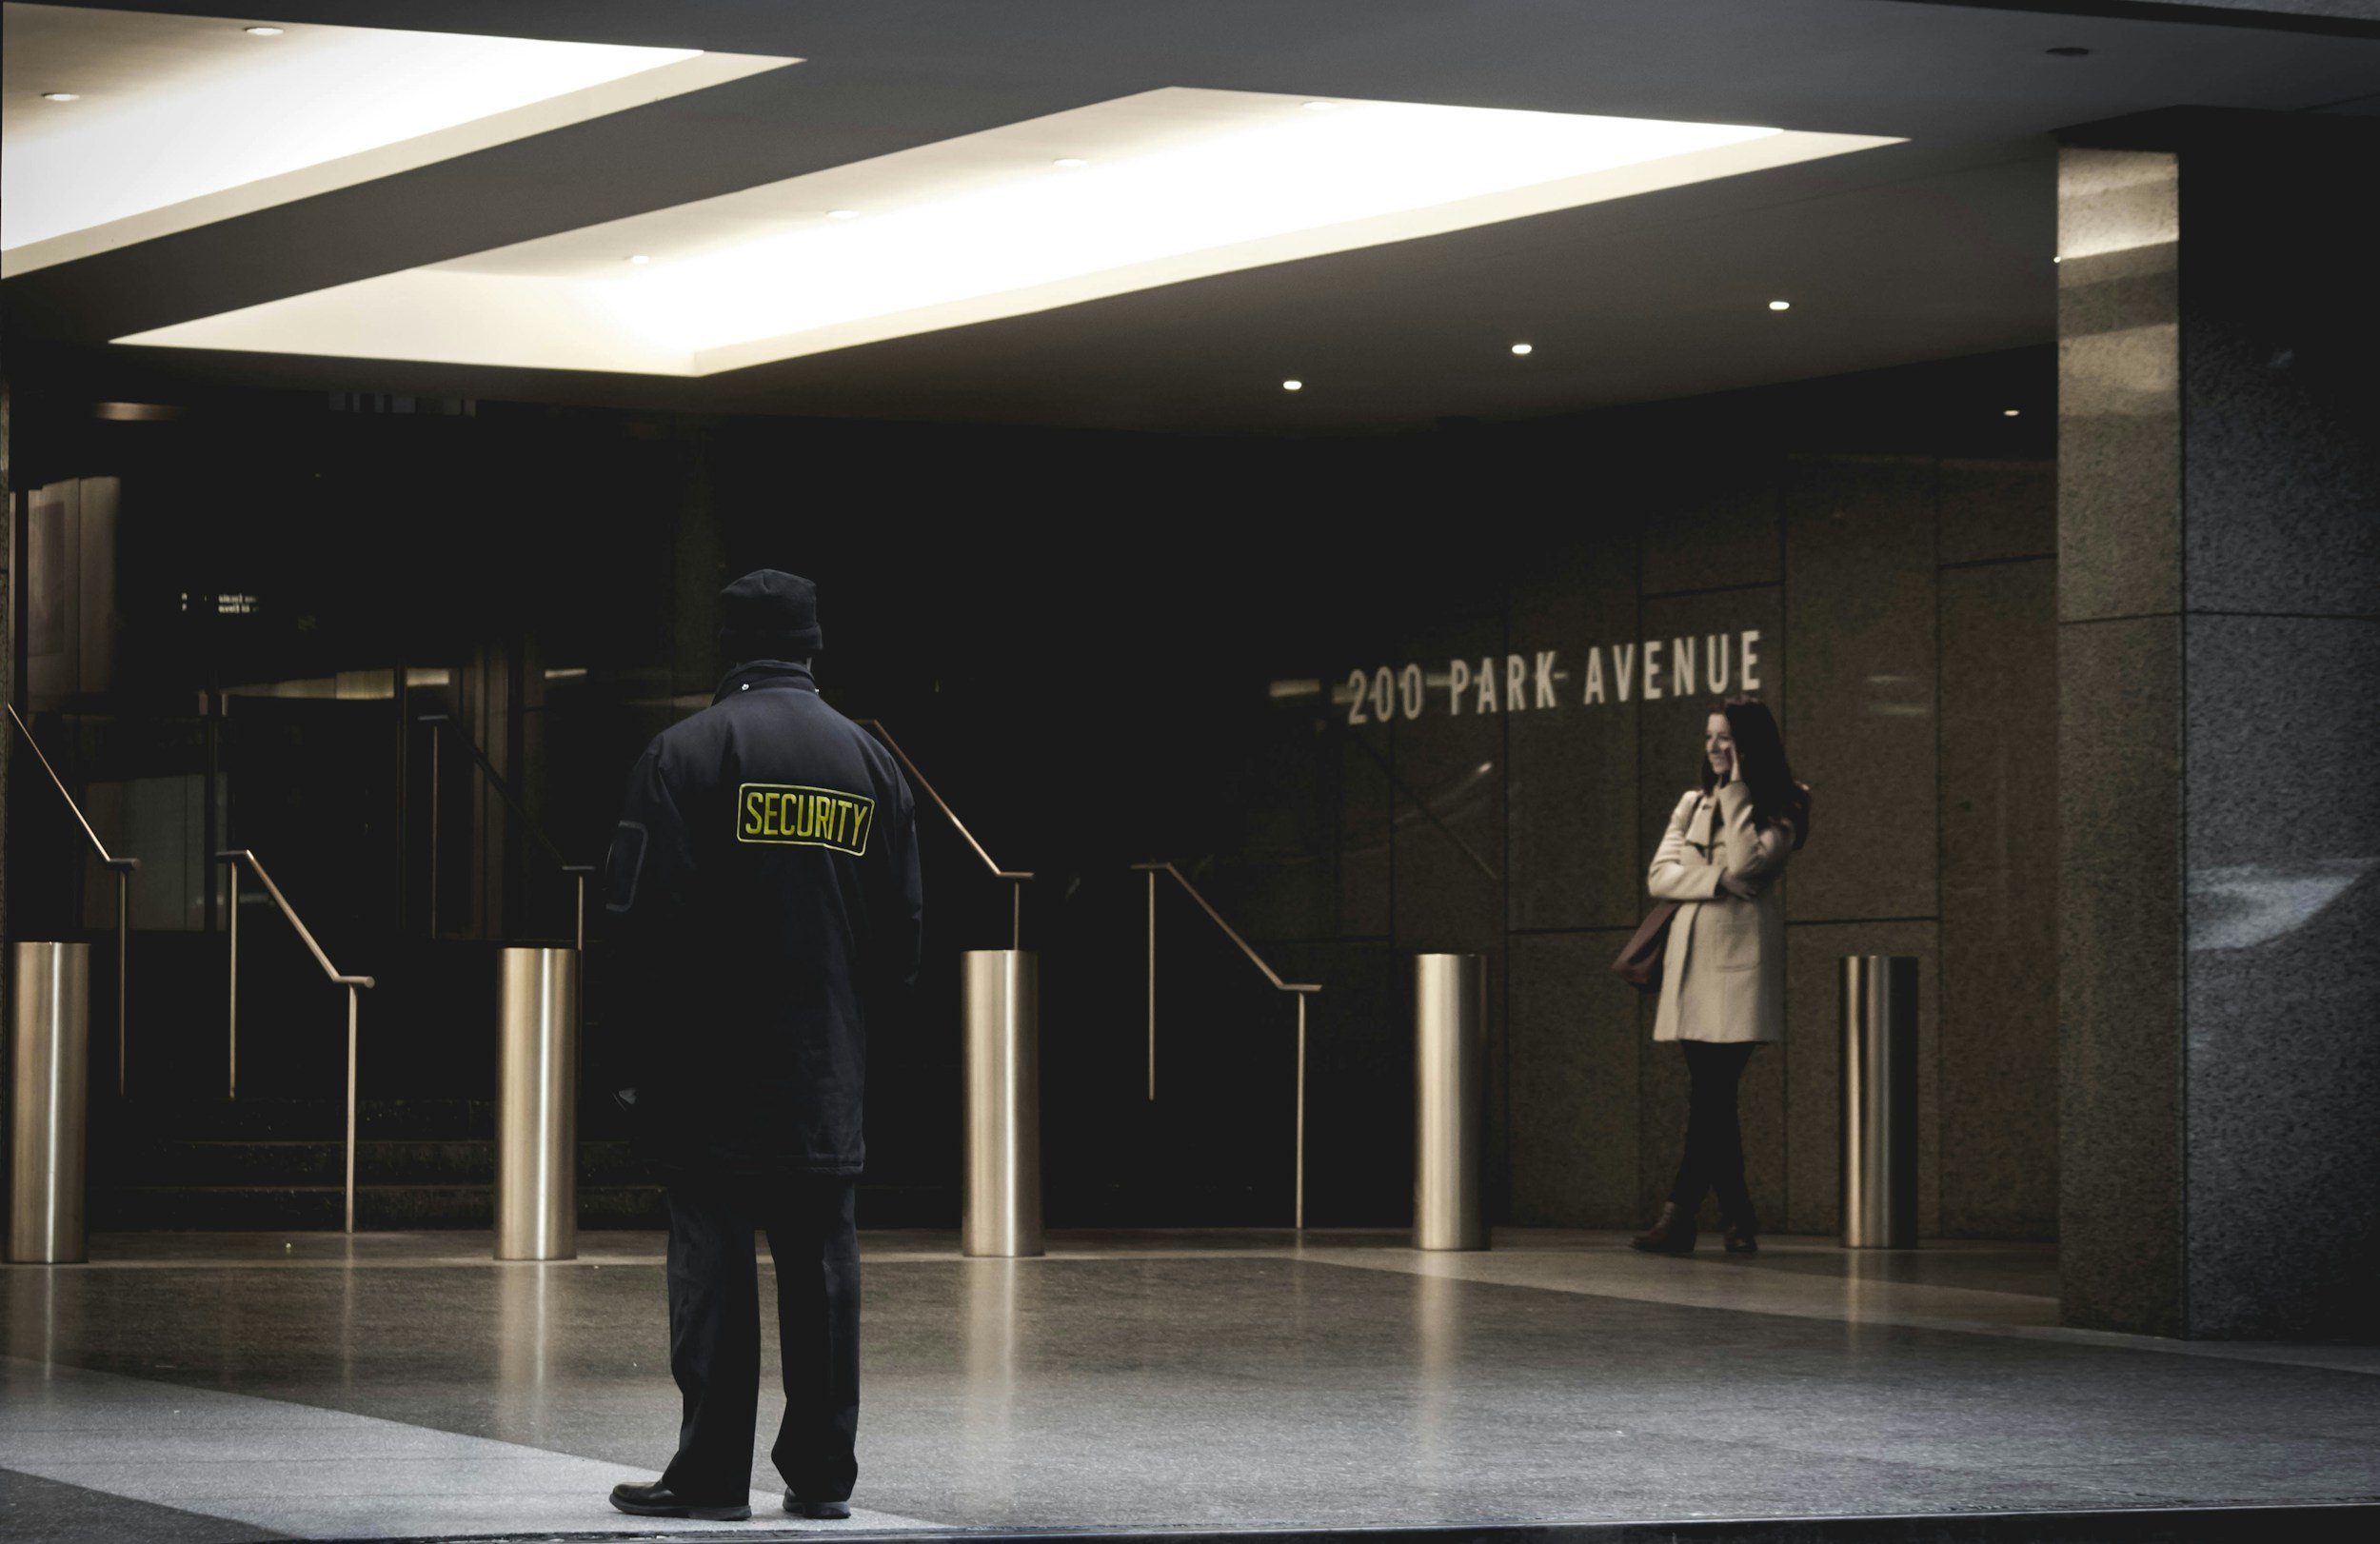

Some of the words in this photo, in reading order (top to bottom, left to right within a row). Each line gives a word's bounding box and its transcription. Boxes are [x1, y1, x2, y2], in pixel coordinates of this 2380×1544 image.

[1347, 663, 1424, 725] 200
[1449, 650, 1557, 716] PARK
[1583, 629, 1760, 705] AVENUE
[745, 792, 868, 846] SECURITY
